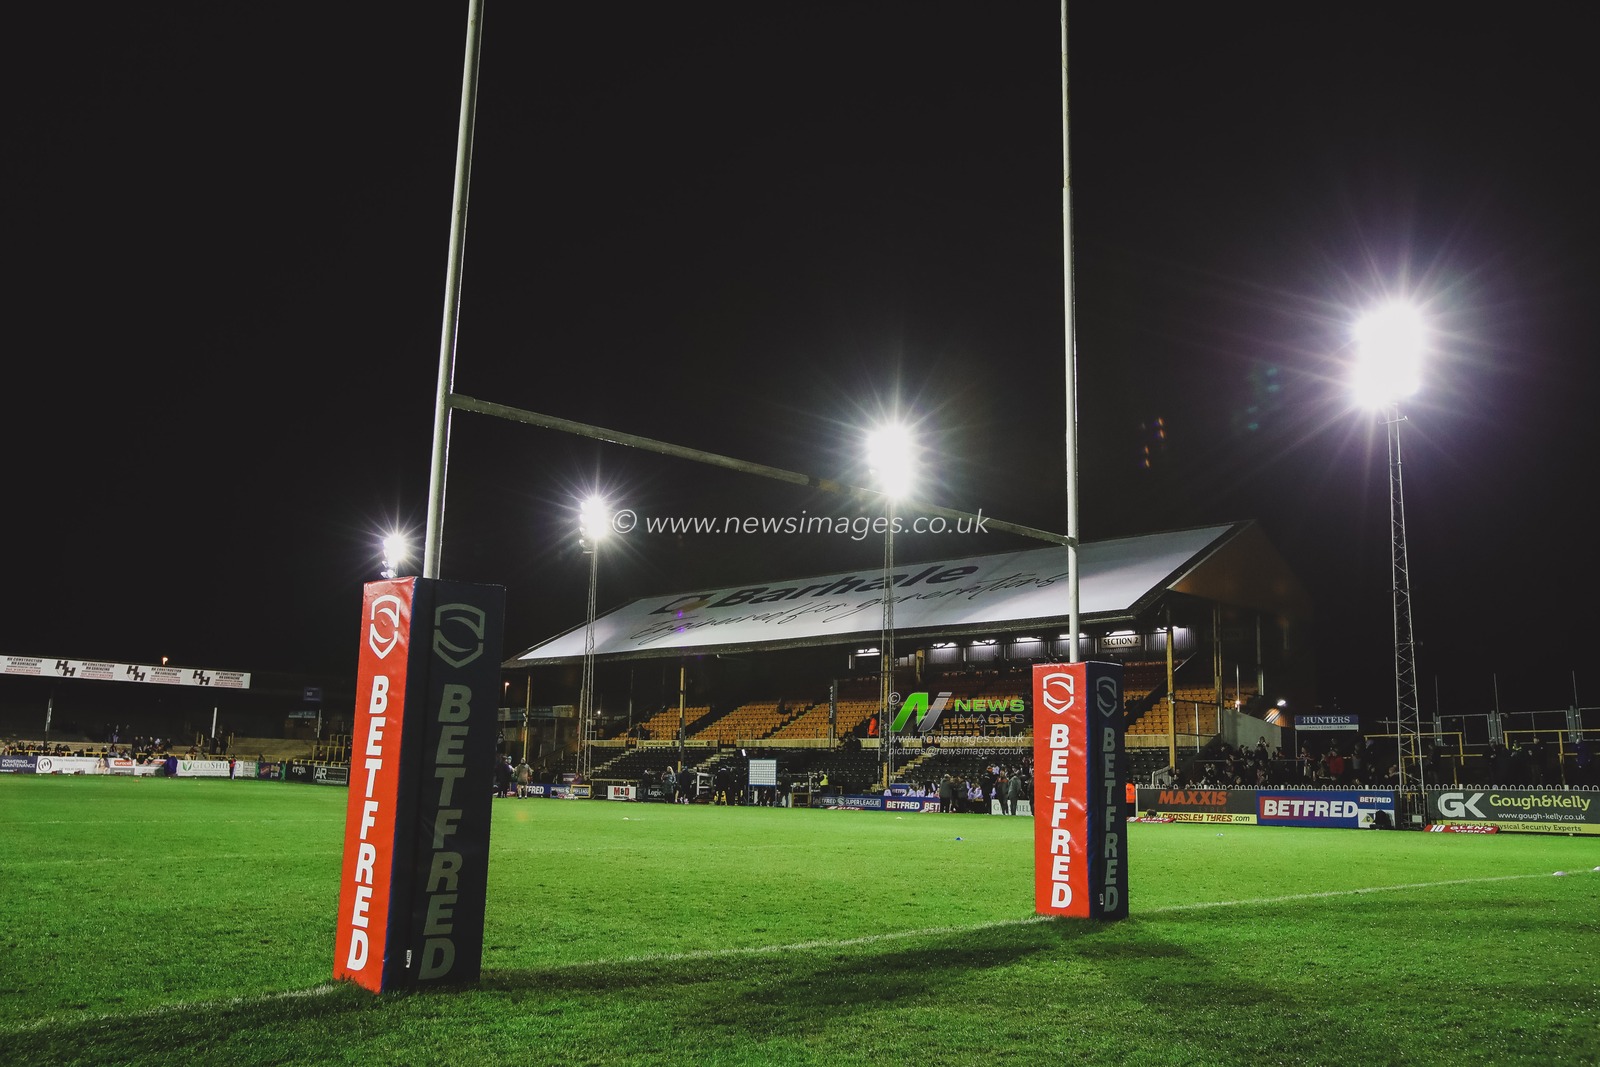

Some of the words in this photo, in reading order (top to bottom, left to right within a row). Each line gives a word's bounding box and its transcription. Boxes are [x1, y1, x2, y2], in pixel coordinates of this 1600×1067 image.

[706, 565, 979, 609] Barhale
[1103, 637, 1132, 646] SECTION
[1134, 636, 1139, 644] 2
[1303, 716, 1350, 724] HUNTERS
[315, 767, 327, 779] AR
[886, 800, 920, 810] BETFRED
[1158, 790, 1228, 806] MAXXIS
[1437, 792, 1487, 818] GK
[1489, 794, 1591, 811] Gough&Kelly
[1050, 723, 1072, 909] BETFRED
[1263, 799, 1359, 818] BETFRED
[1497, 812, 1586, 821] www.gough-kelly.co.uk
[347, 676, 389, 971] BETFRED
[1103, 727, 1119, 912] BETFRED
[1161, 812, 1204, 822] CROSSLEY
[1206, 813, 1233, 822] TYRES
[418, 684, 472, 980] BETFRED
[1430, 824, 1445, 832] 10
[1521, 823, 1551, 832] Security
[1553, 824, 1582, 832] Experts
